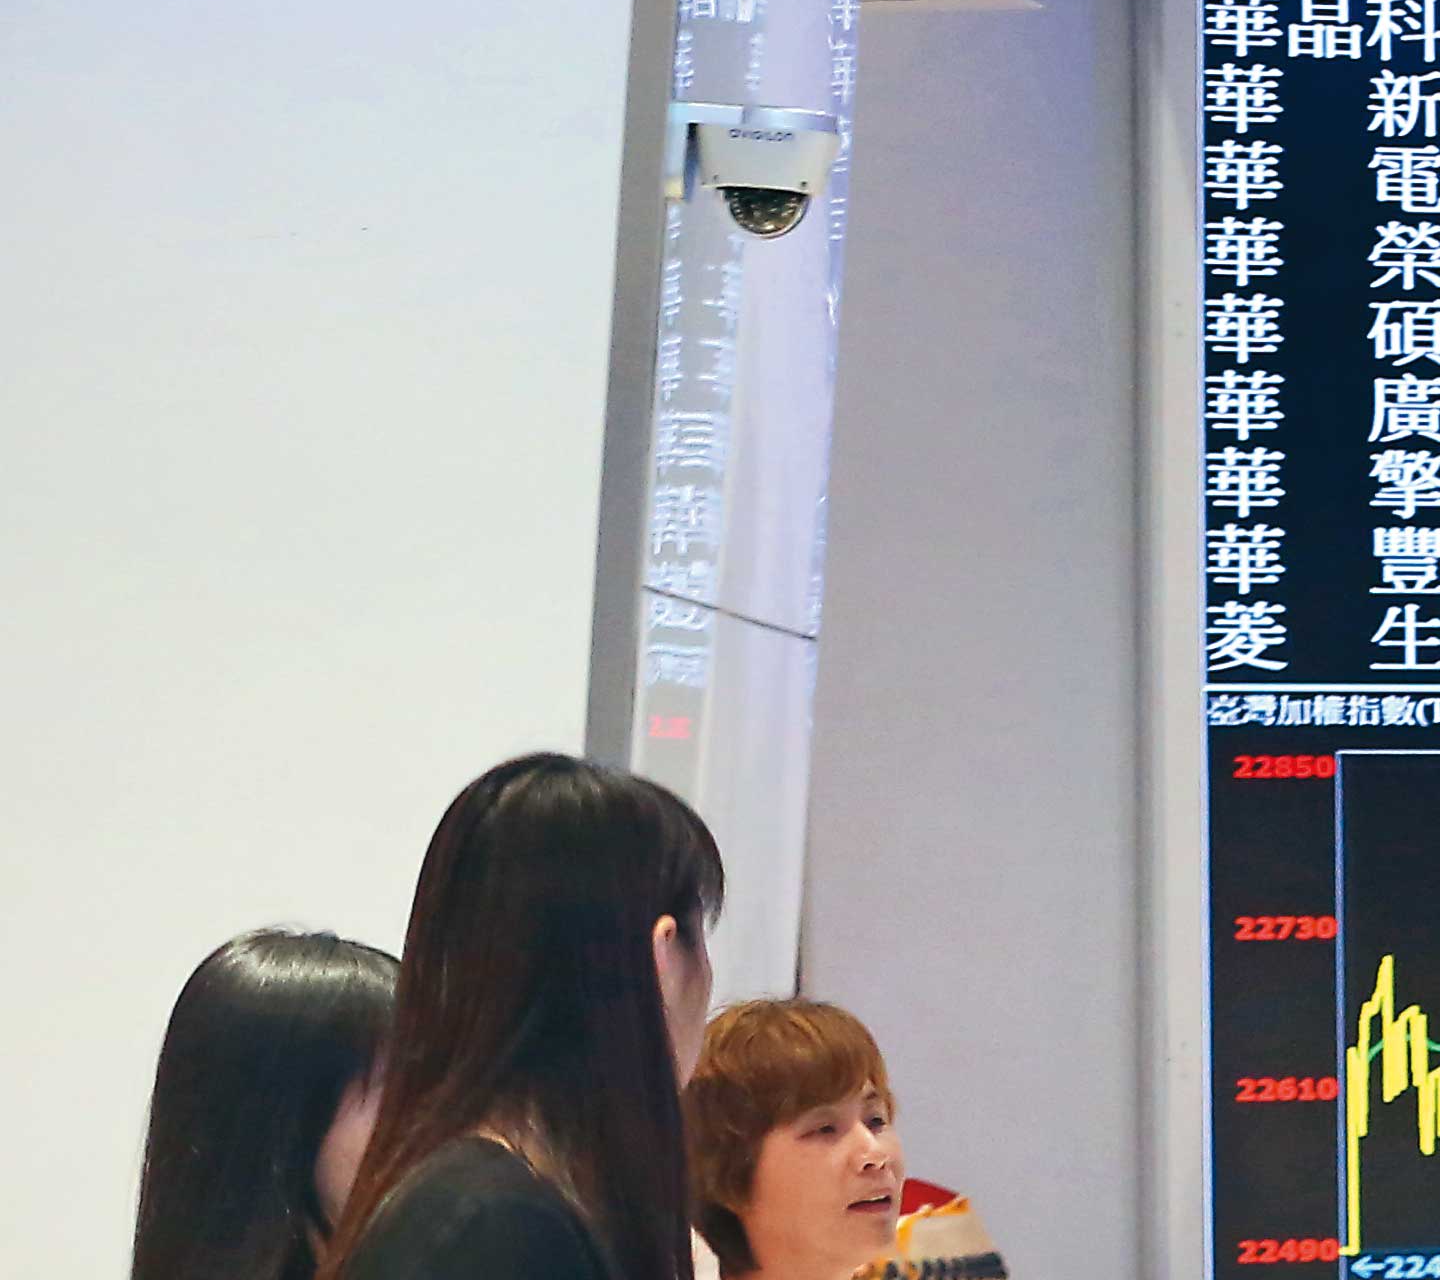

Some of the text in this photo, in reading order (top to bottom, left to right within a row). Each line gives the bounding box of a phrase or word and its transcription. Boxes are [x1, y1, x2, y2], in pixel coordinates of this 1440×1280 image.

[1234, 755, 1337, 778] 22850
[1235, 916, 1338, 940] 22730
[1235, 1077, 1340, 1102] 22610
